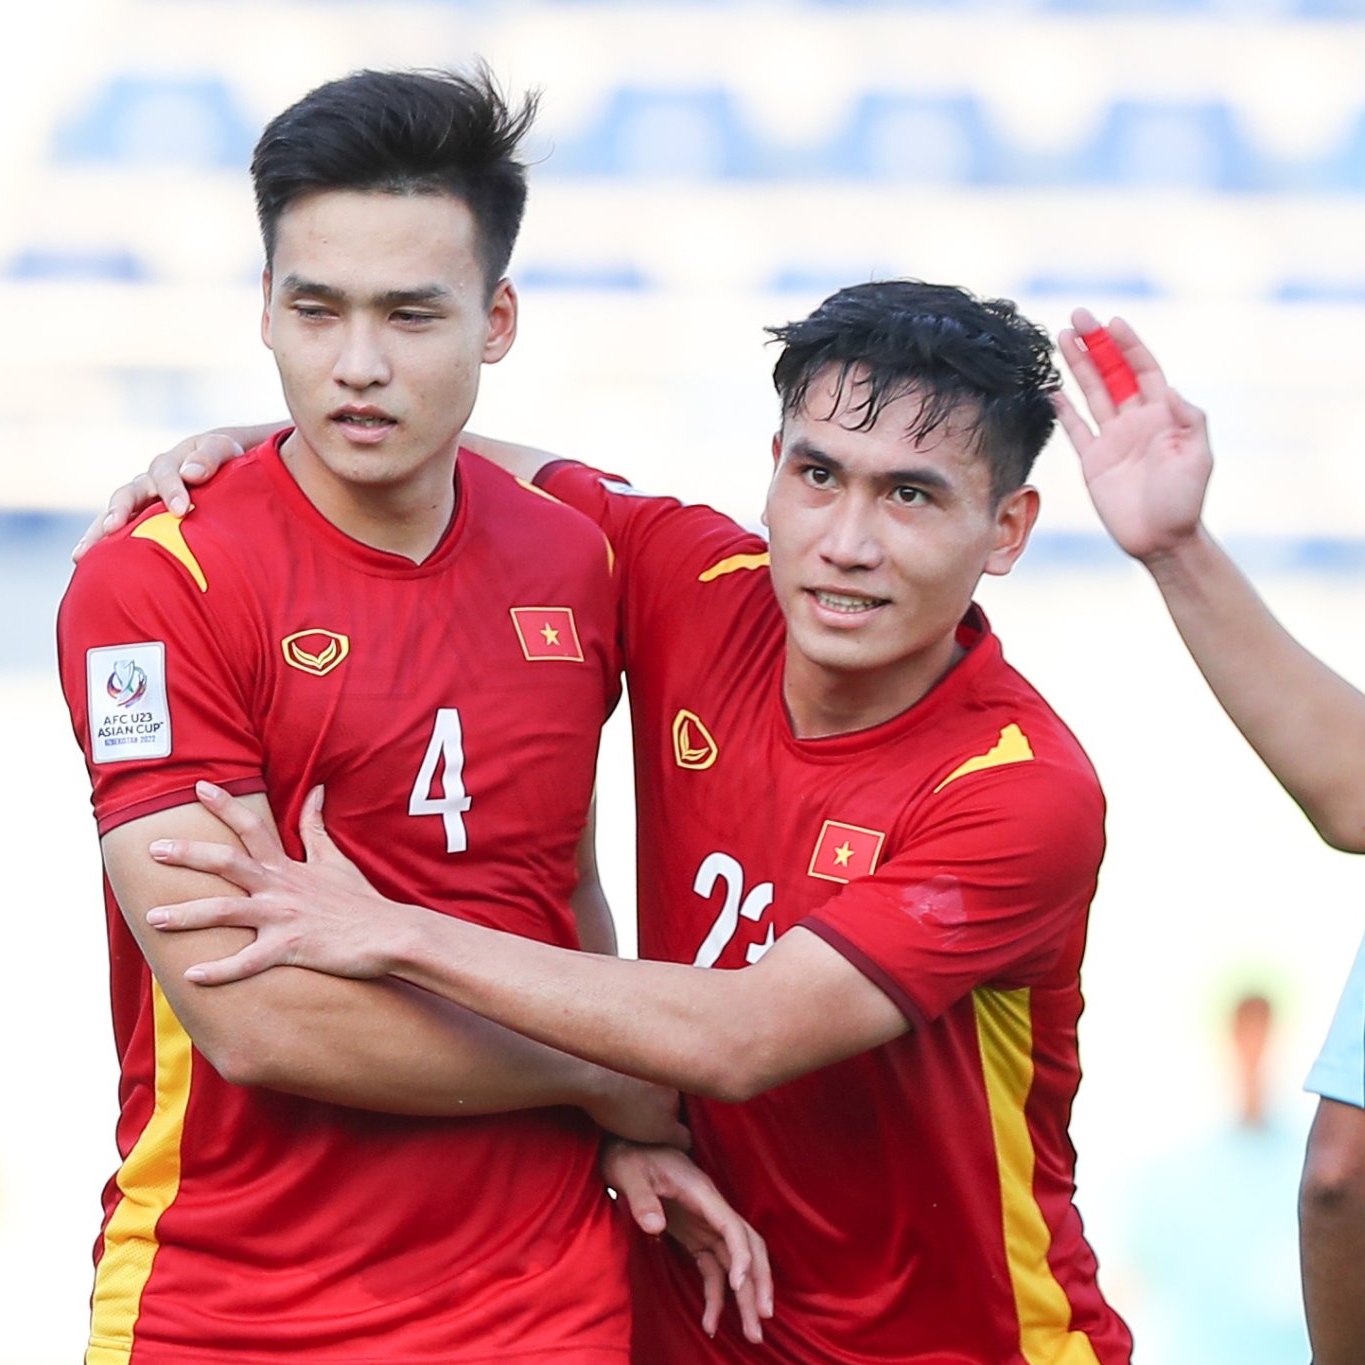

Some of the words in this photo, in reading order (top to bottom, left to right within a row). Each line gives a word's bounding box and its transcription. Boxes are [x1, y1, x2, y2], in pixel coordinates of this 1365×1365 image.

[104, 715, 128, 725] AFC
[131, 712, 153, 723] U23
[98, 726, 133, 738] ASIAN
[136, 723, 161, 734] CUP
[408, 708, 472, 853] 4
